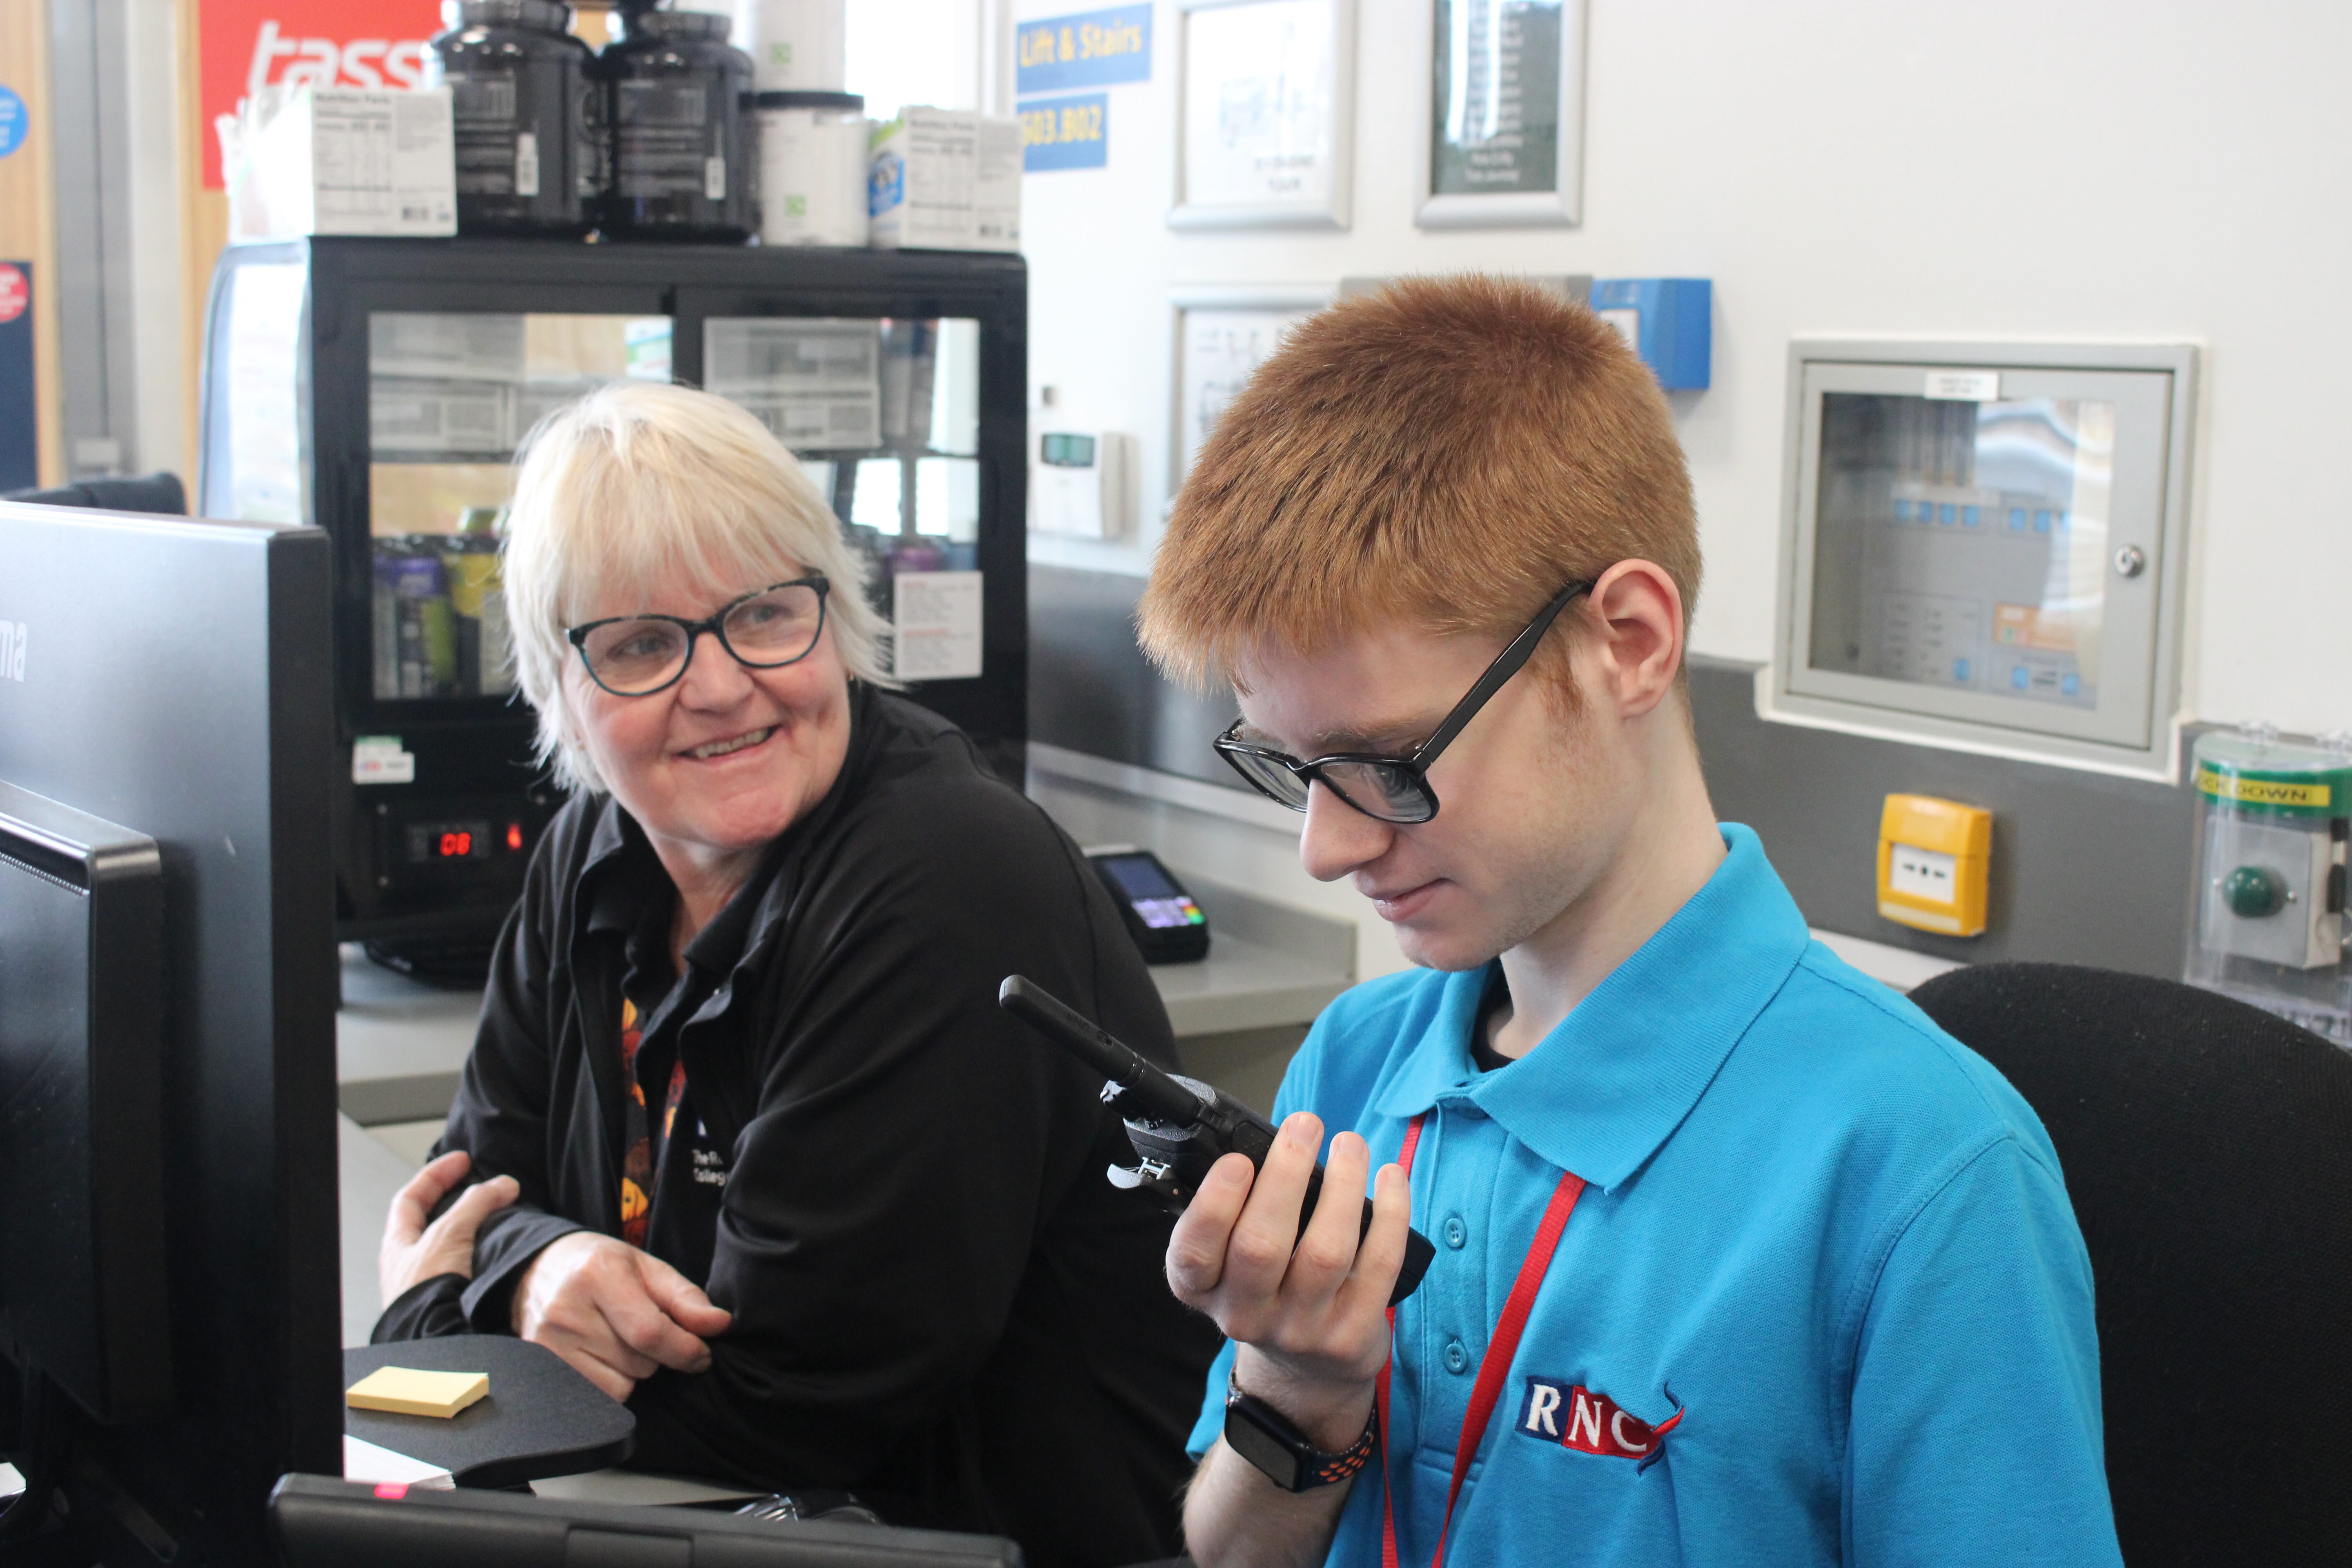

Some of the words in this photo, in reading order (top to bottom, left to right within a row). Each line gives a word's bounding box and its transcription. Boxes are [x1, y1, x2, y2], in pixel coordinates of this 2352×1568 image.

[1020, 27, 1055, 67] Lift
[1058, 25, 1075, 62] &
[1079, 18, 1142, 60] Stairs
[1525, 1384, 1647, 1452] RNC
